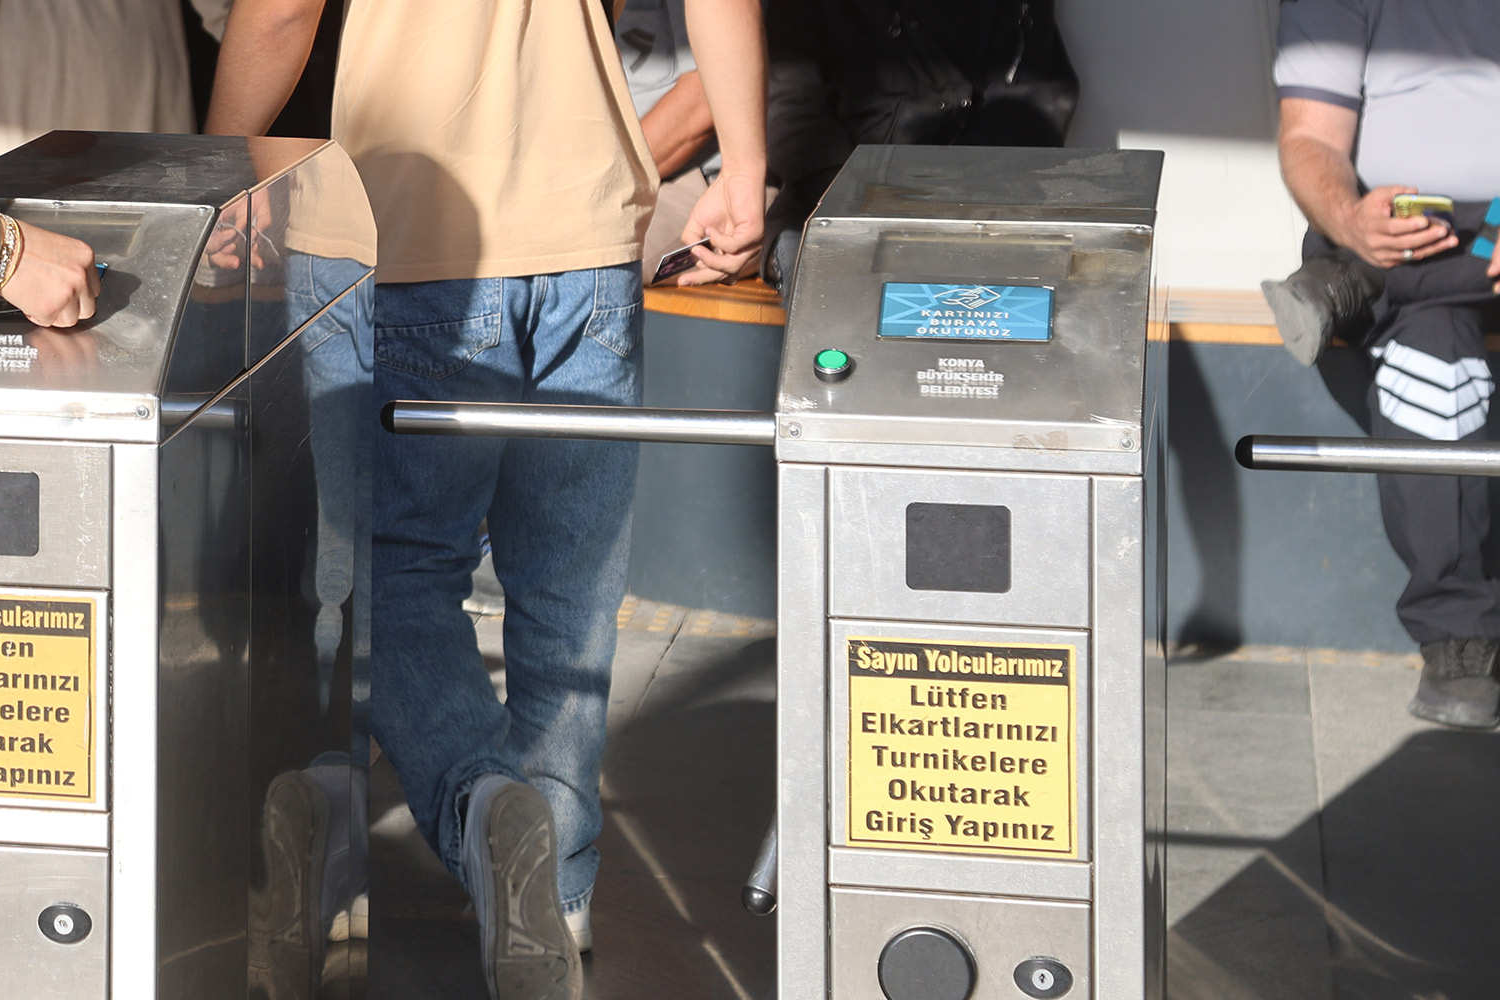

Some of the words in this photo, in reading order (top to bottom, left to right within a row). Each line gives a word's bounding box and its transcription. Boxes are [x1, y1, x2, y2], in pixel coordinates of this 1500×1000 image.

[921, 310, 1010, 319] KARTINIZI
[930, 318, 998, 327] BURAYA
[916, 327, 1011, 336] OKUTUNUZ
[938, 358, 985, 368] KONYA
[917, 369, 1004, 383] BÜYÜKŞEHİR
[920, 384, 999, 396] BELEDİYESİ
[856, 645, 919, 675] Sayın
[925, 649, 1063, 679] Yolcularımız
[910, 685, 1008, 711] Lütfen
[861, 712, 1058, 743] Elkartlarınızı
[872, 745, 1048, 775] Turnikelere
[888, 778, 1030, 807] Okutarak
[865, 810, 934, 840] Giriş
[945, 814, 1055, 842] Yapınız
